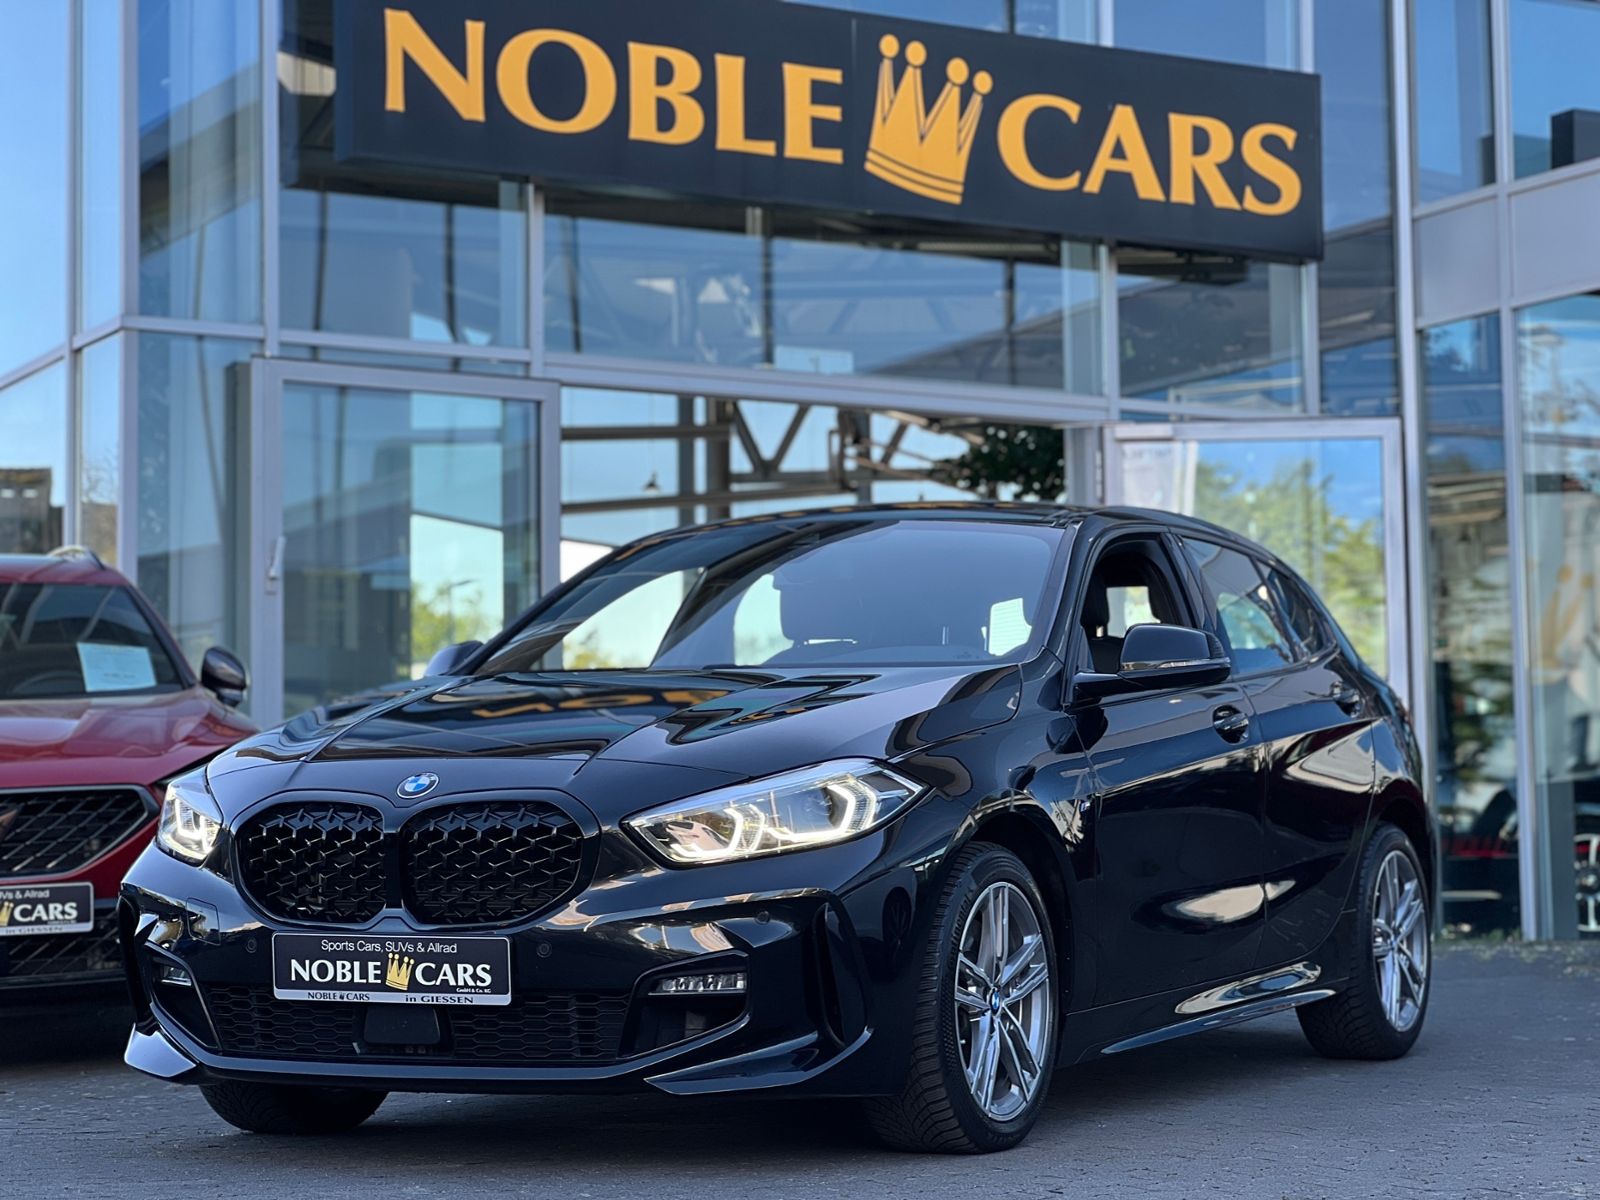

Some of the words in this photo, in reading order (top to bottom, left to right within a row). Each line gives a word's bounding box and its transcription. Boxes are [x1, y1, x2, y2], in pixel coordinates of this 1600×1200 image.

[383, 8, 844, 165] NOBLE
[996, 93, 1303, 217] CARS
[13, 902, 78, 922] CARS
[321, 939, 356, 952] Sports
[356, 940, 384, 953] Cars,
[385, 941, 415, 953] SUVs
[416, 942, 425, 953] &
[426, 942, 458, 954] Allrad
[290, 958, 382, 984] NOBLE
[414, 962, 493, 987] CARS
[307, 991, 338, 1000] NOBLE
[345, 993, 371, 1002] CARS
[405, 994, 417, 1003] in
[420, 995, 475, 1004] GIESSEN
